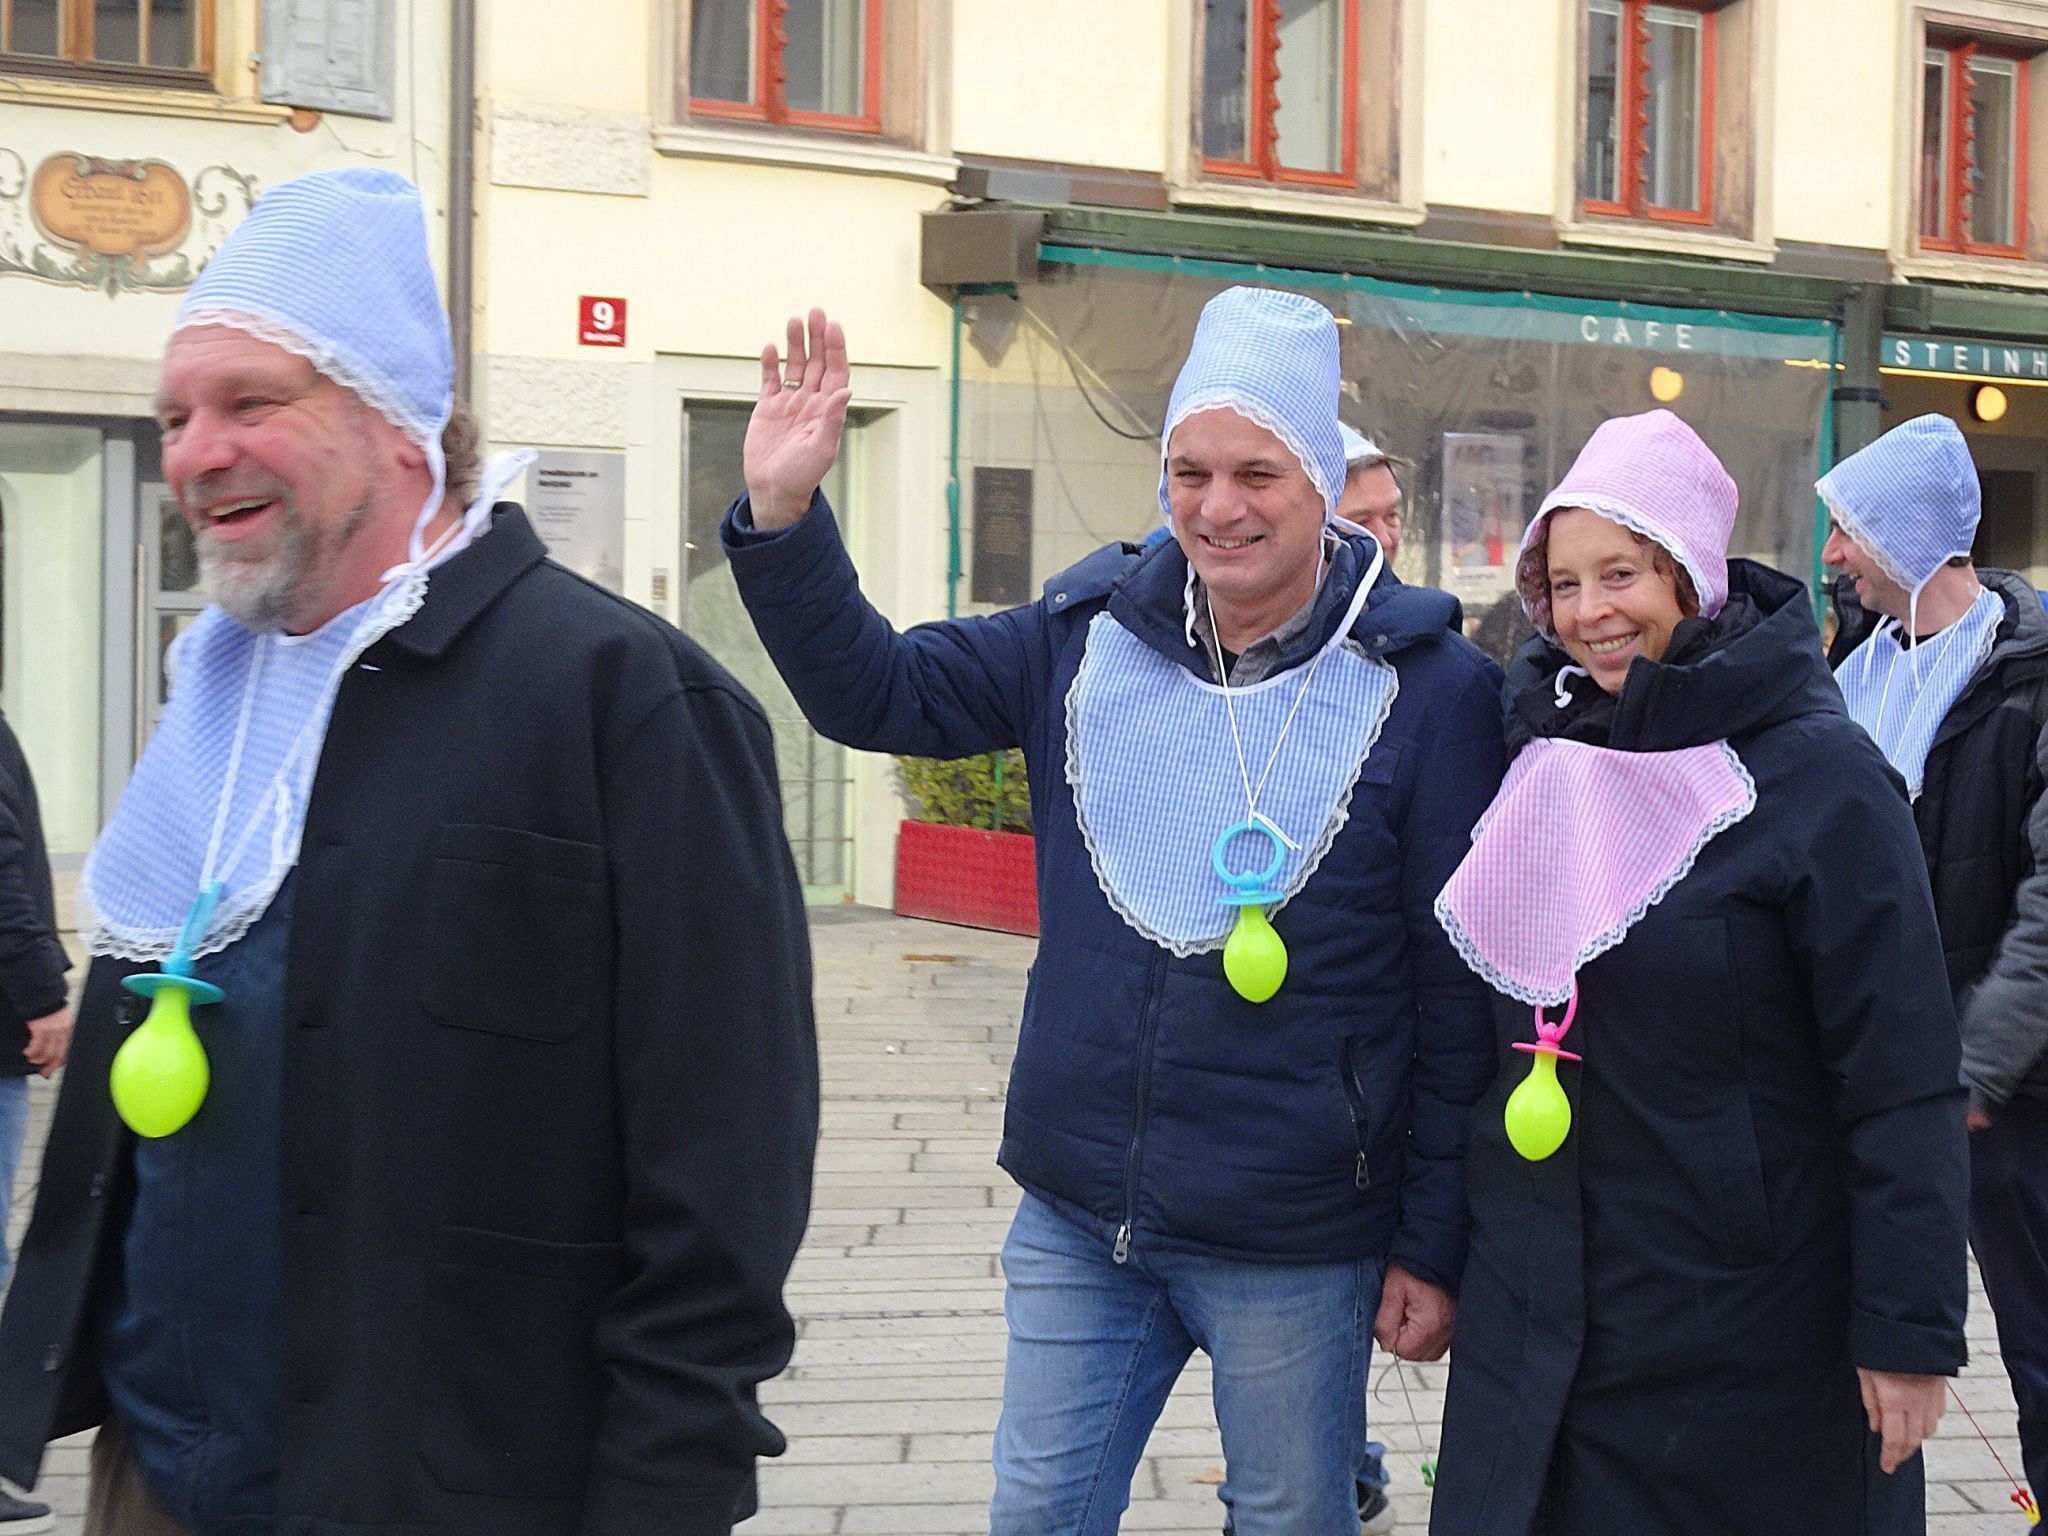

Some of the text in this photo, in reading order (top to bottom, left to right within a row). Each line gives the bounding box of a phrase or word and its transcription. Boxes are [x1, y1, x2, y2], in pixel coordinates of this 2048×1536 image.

[592, 301, 615, 330] 9
[1581, 314, 2048, 376] CAFE STEINH
